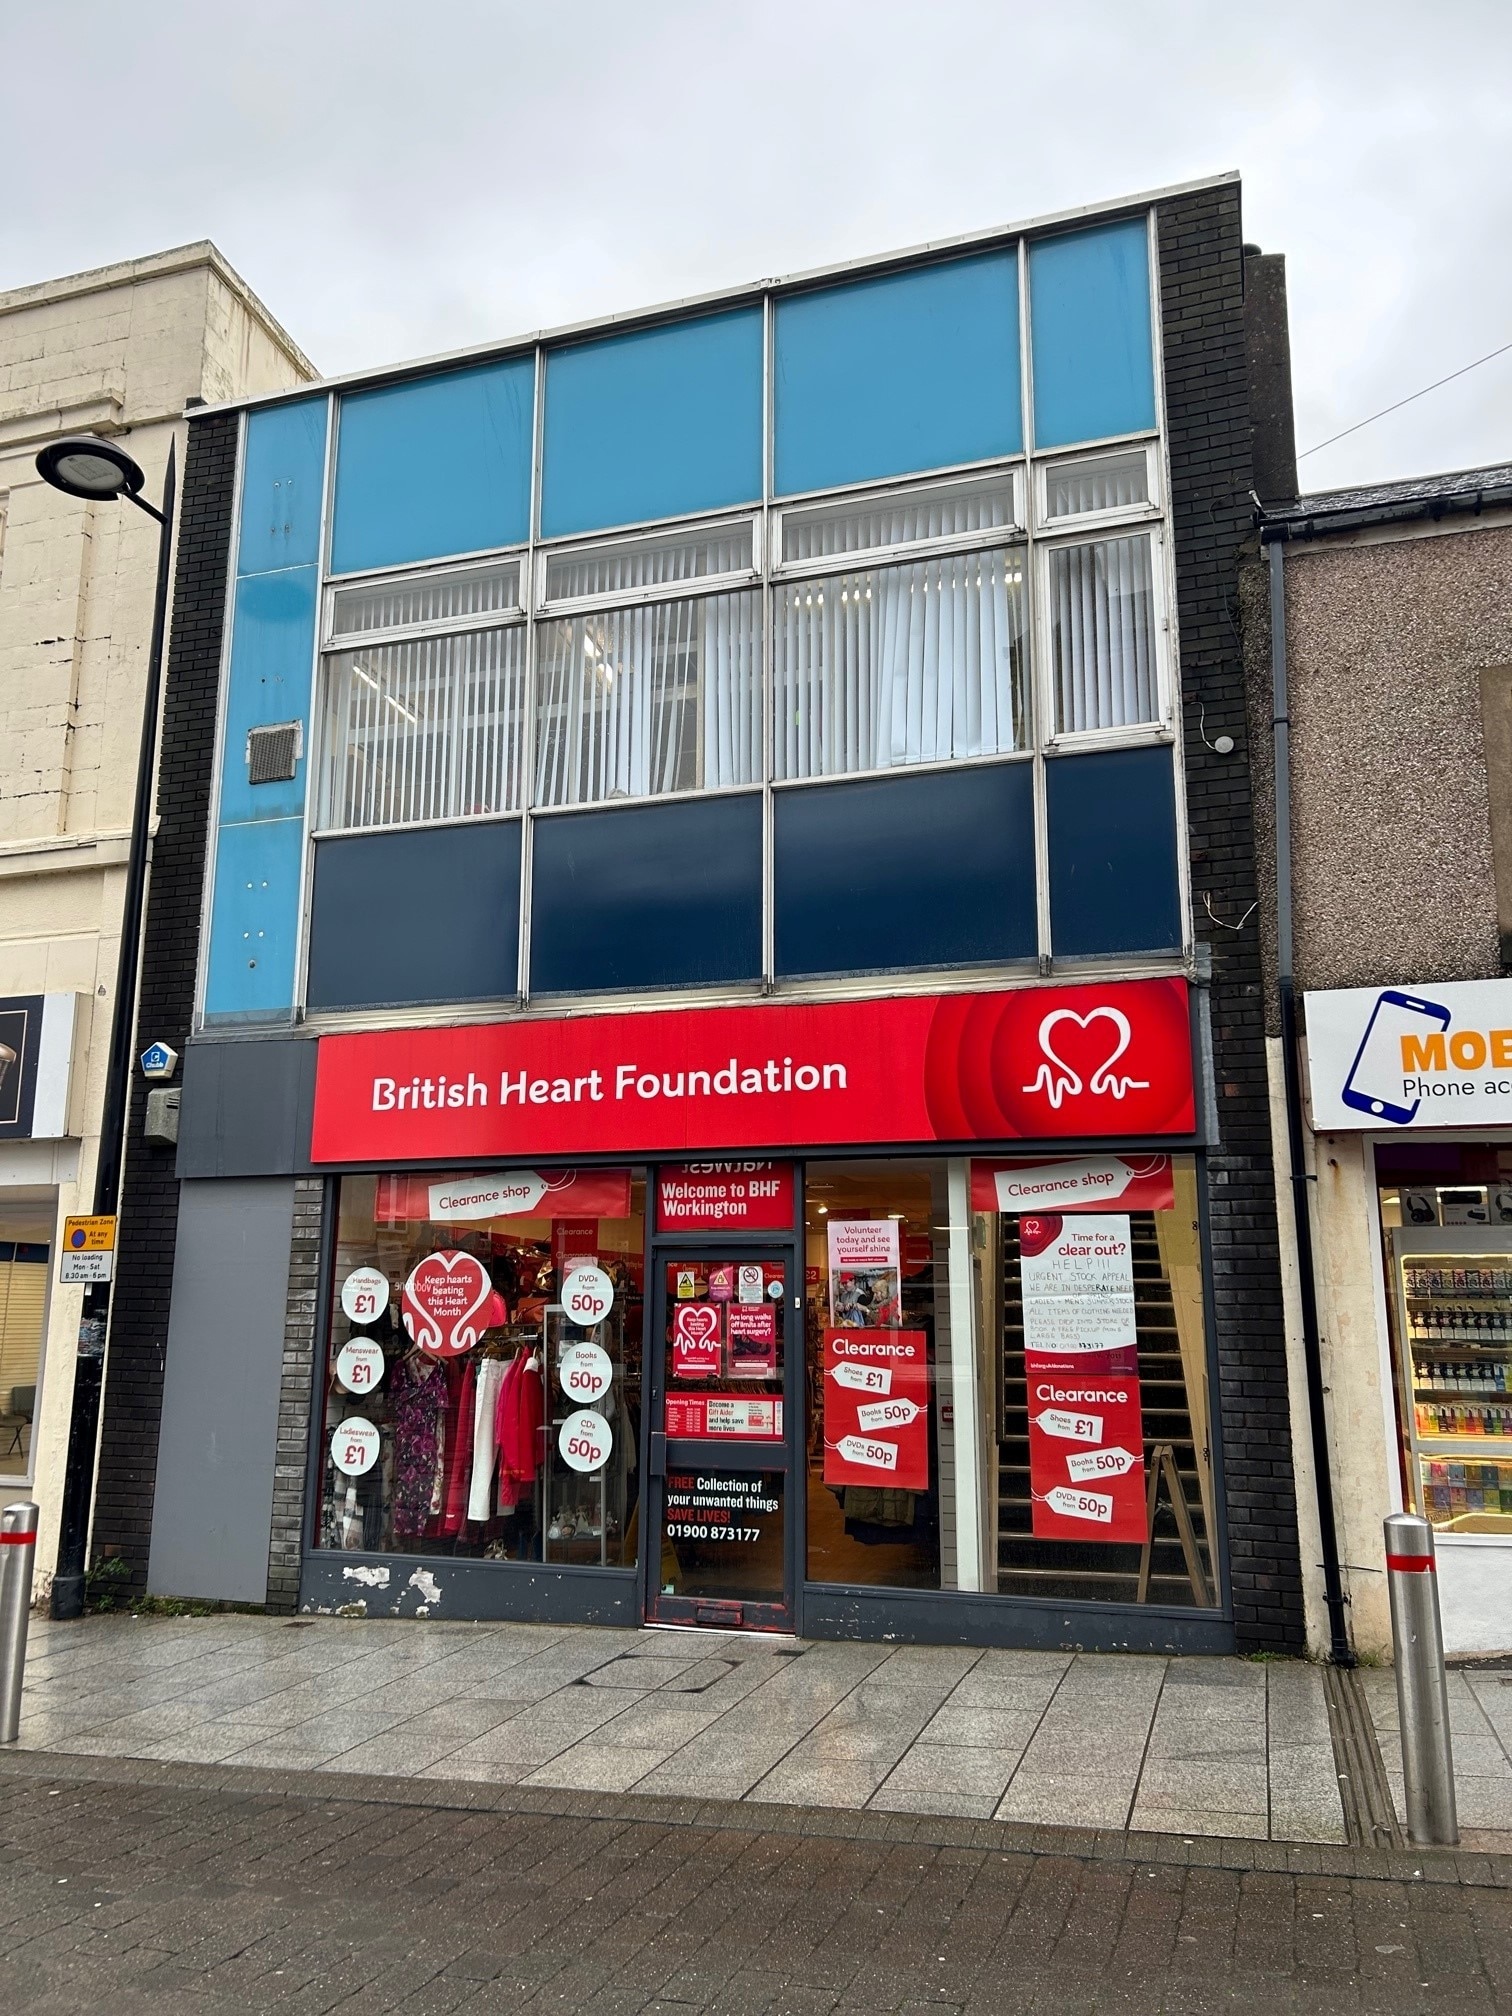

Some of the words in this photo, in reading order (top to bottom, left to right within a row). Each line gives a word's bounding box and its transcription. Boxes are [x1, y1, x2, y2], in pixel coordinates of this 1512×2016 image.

[372, 1072, 488, 1111] British
[500, 1069, 604, 1105] Heart
[615, 1057, 848, 1100] Foundation
[1403, 1076, 1475, 1098] Phone
[1484, 1081, 1512, 1094] ac
[661, 1182, 726, 1199] Welcome
[730, 1183, 745, 1198] to
[749, 1180, 780, 1197] BHF
[1008, 1178, 1078, 1197] Clearance
[1082, 1172, 1114, 1186] shop
[439, 1191, 500, 1210] Clearance
[502, 1185, 531, 1200] shop
[663, 1200, 747, 1218] Workington
[556, 1227, 594, 1236] Clearance
[836, 1236, 859, 1245] today
[837, 1245, 869, 1254] yourself
[1059, 1243, 1091, 1256] clear
[1094, 1243, 1126, 1256] out?
[424, 1275, 445, 1286] Keep
[446, 1275, 472, 1283] hearts
[1070, 1273, 1097, 1281] STOCK
[1102, 1273, 1130, 1281] APPEAL
[432, 1286, 464, 1296] beating
[354, 1295, 376, 1313] £1
[428, 1297, 443, 1305] this
[571, 1294, 604, 1316] 50p
[433, 1307, 461, 1316] Month
[741, 1314, 754, 1322] long
[746, 1328, 771, 1336] surgery?
[832, 1338, 916, 1357] Clearance
[352, 1364, 371, 1383] £1
[844, 1366, 863, 1376] Shoes
[866, 1372, 883, 1388] £1
[570, 1372, 602, 1393] 50p
[1036, 1384, 1128, 1403] Clearance
[884, 1405, 911, 1420] 50p
[340, 1428, 375, 1437] Ladieswear
[581, 1420, 596, 1428] CDs
[1050, 1414, 1071, 1424] Shoes
[1074, 1420, 1093, 1436] £1
[344, 1445, 365, 1465] £1
[568, 1438, 601, 1463] 50p
[846, 1440, 865, 1450] DVDs
[866, 1445, 892, 1464] 50p
[1071, 1459, 1094, 1467] Books
[1096, 1455, 1126, 1471] 50p
[667, 1477, 694, 1489] FREE
[697, 1477, 748, 1492] Collection
[751, 1480, 762, 1493] of
[667, 1495, 690, 1507] your
[693, 1496, 743, 1508] unwanted
[745, 1496, 779, 1512] things
[1056, 1491, 1076, 1501] DVDs
[1078, 1497, 1108, 1517] 50p
[667, 1508, 694, 1520] SAVE
[697, 1509, 730, 1523] LIVES!
[667, 1524, 708, 1538] 01900
[711, 1527, 760, 1541] 873177
